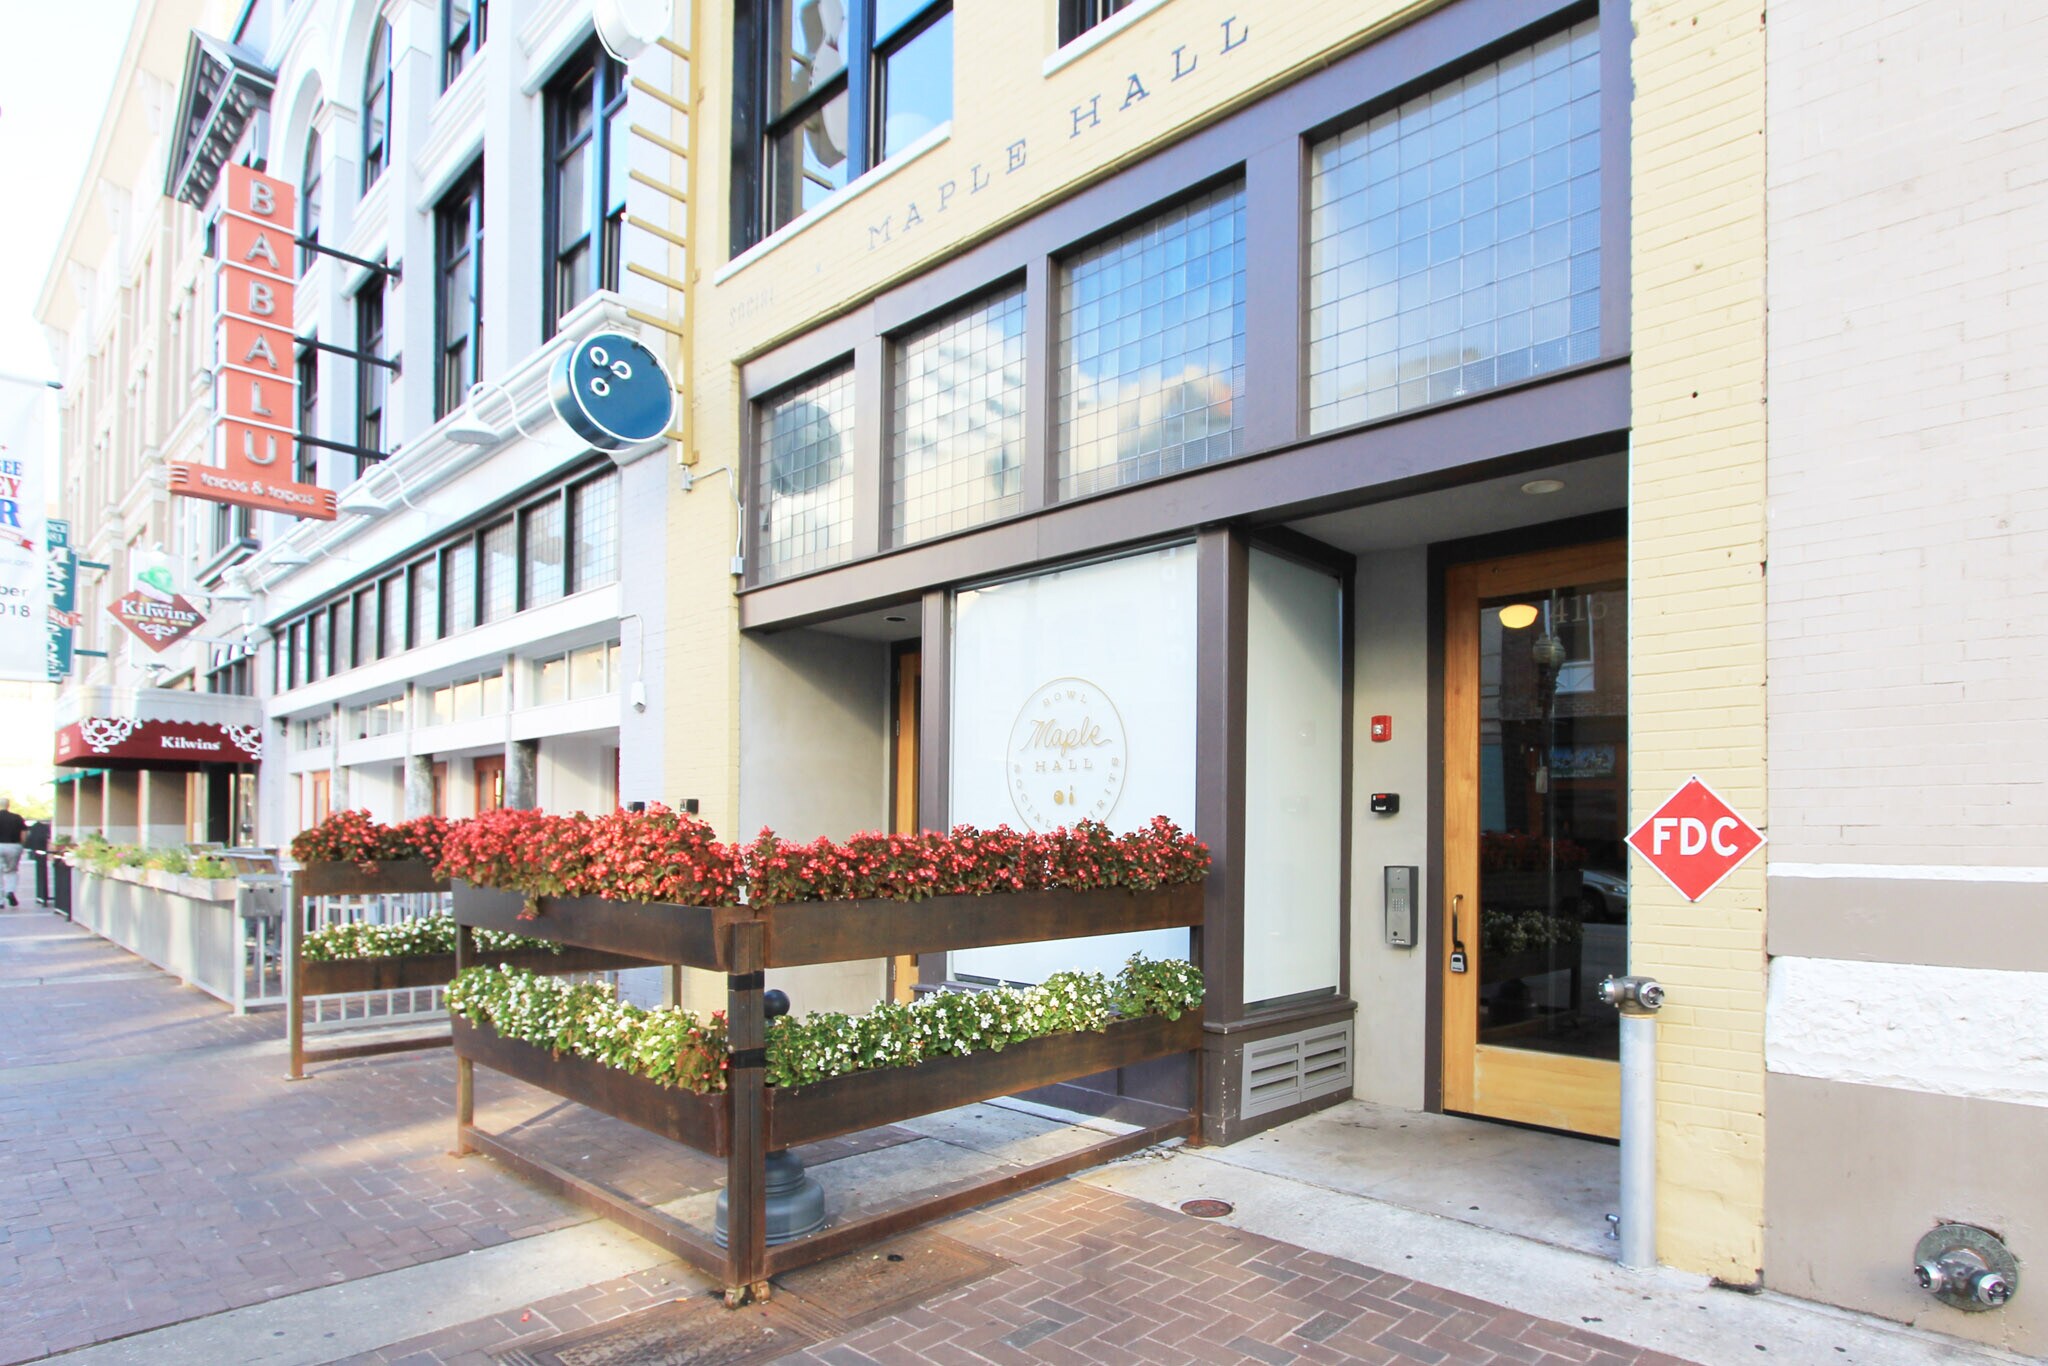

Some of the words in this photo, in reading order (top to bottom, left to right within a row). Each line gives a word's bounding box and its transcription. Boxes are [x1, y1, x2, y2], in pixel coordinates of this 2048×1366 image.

[867, 137, 1027, 251] MAPLE
[1069, 15, 1249, 139] HALL
[244, 178, 279, 465] BABALU
[0, 460, 22, 477] EE
[200, 472, 249, 494] tacos
[251, 480, 264, 496] &
[267, 485, 315, 505] tapas
[121, 599, 198, 622] Kilwins
[1042, 689, 1088, 708] BOWL
[160, 735, 220, 751] Kilwins
[1019, 715, 1113, 758] Maple
[1034, 757, 1094, 773] HALL
[1068, 756, 1120, 832] SIRITS
[1652, 816, 1739, 857] FDC
